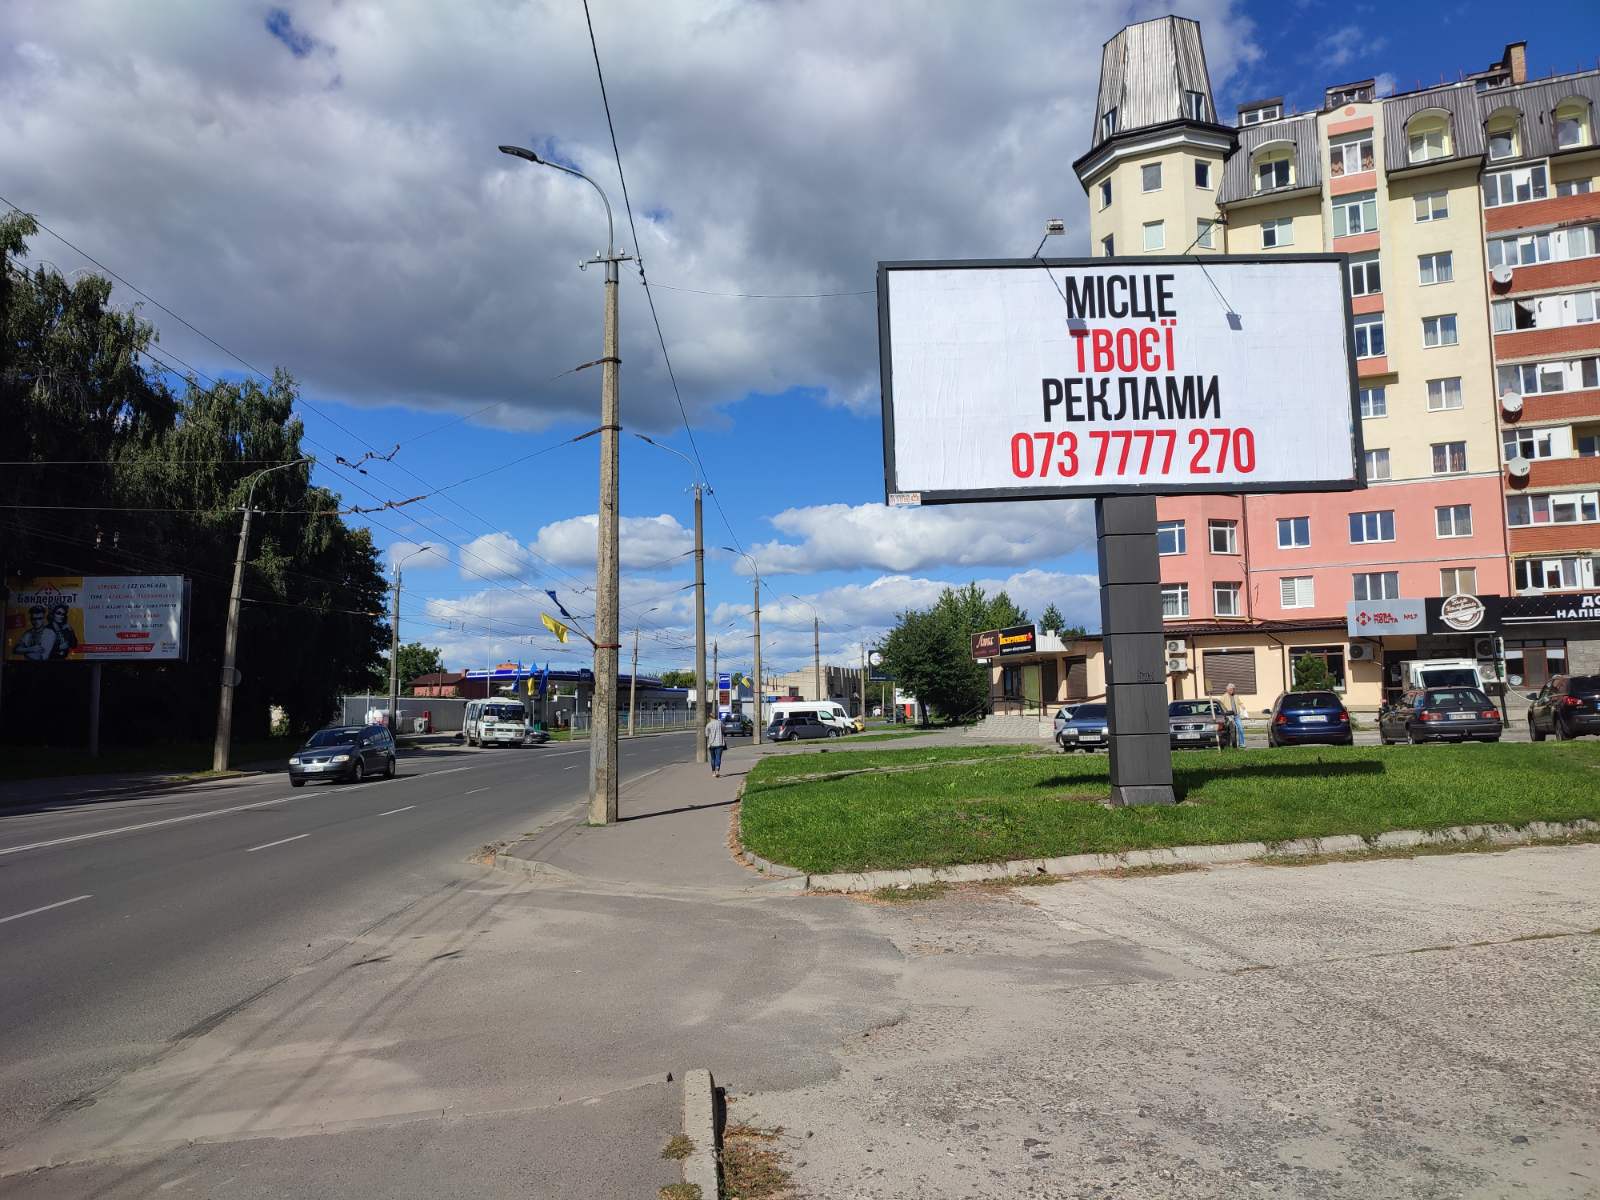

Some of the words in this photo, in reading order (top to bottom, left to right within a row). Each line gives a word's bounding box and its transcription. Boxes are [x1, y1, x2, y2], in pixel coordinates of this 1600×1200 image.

[1065, 274, 1176, 322] МІСЦЕ
[1069, 319, 1176, 373] ТВОЄЇ
[1042, 374, 1221, 423] РЕКЛАМИ
[1010, 431, 1079, 479] 073
[1089, 429, 1177, 477] 7777
[1188, 427, 1256, 474] 270
